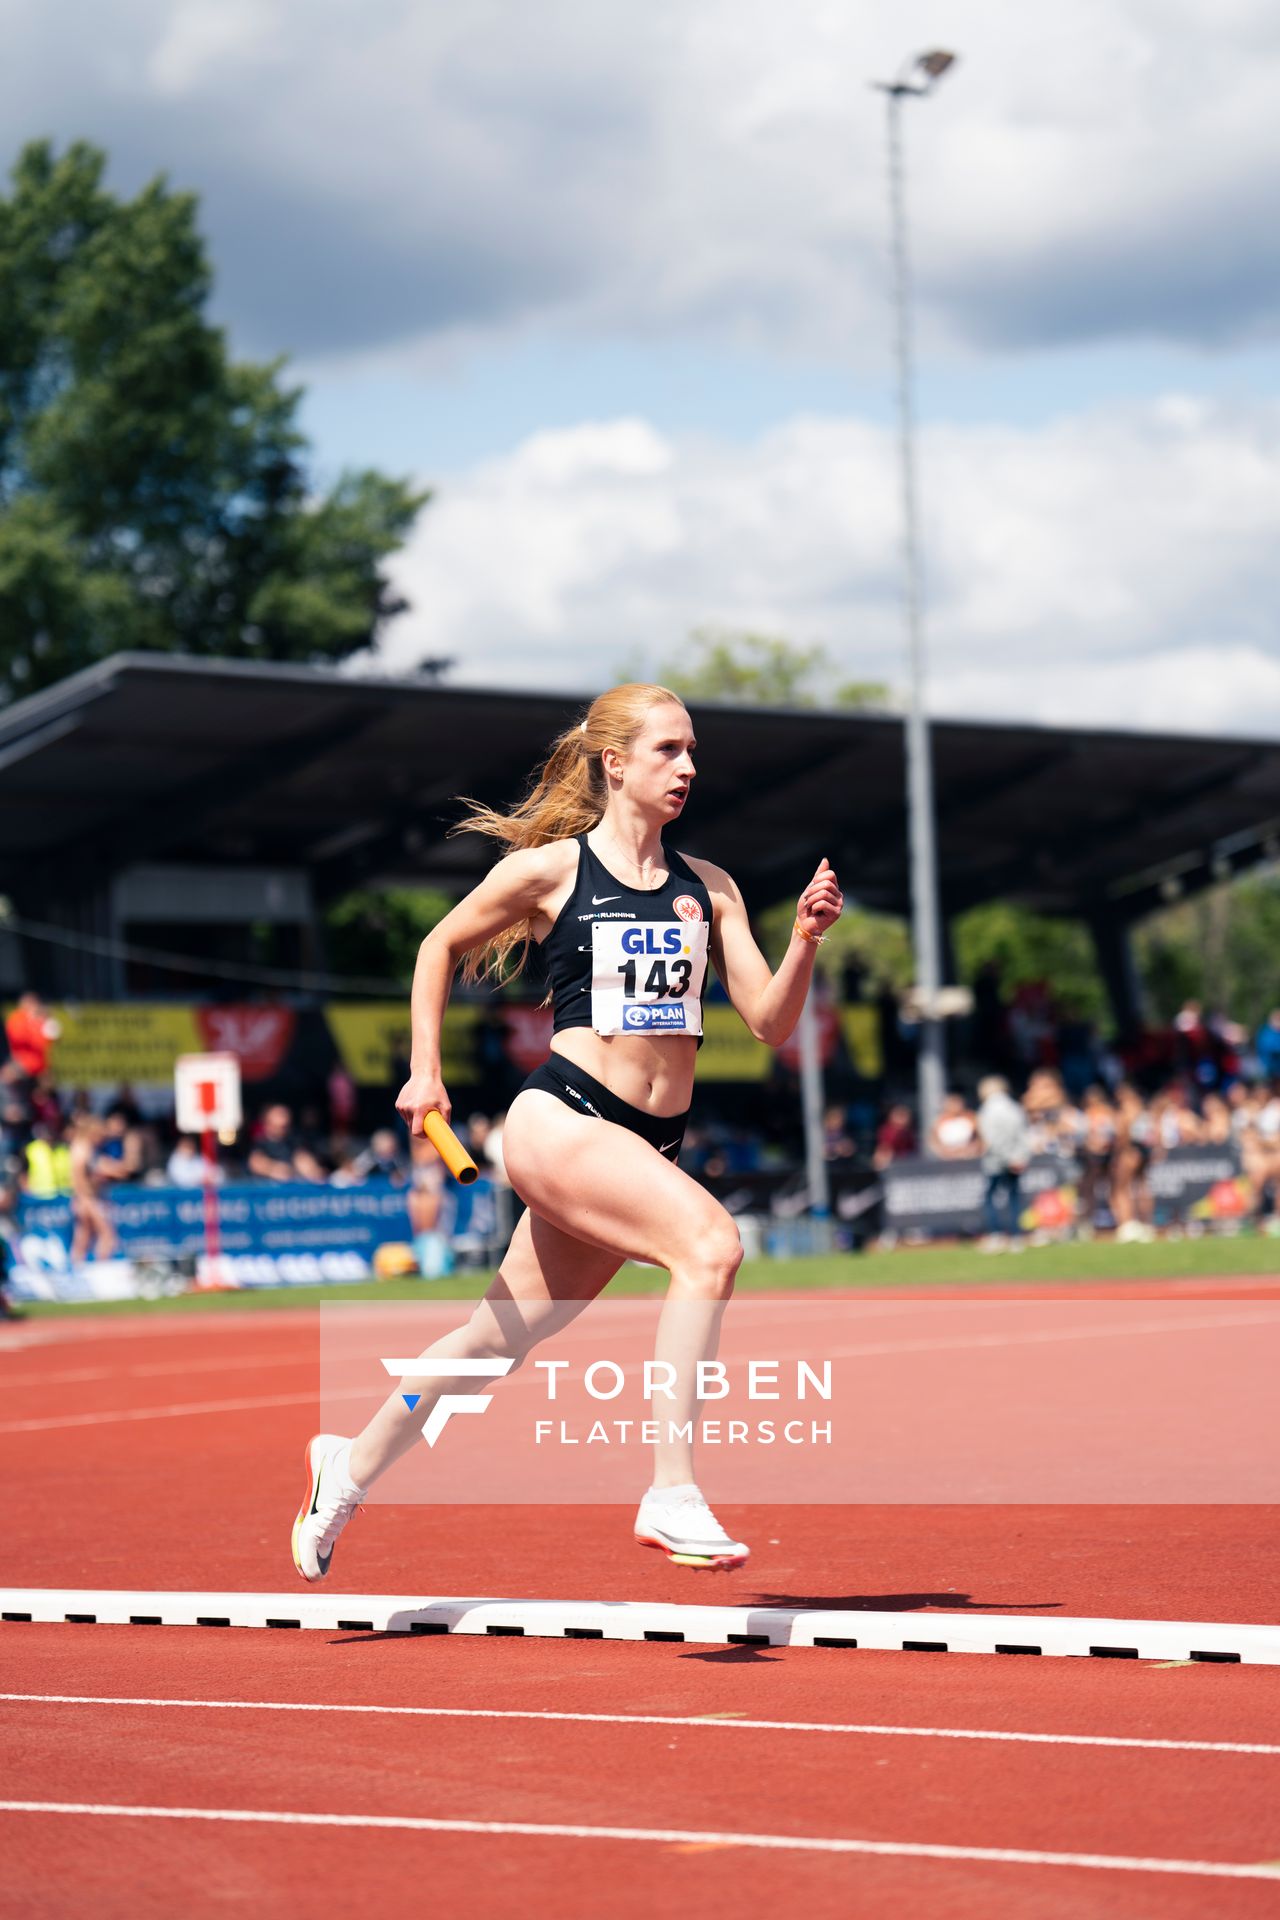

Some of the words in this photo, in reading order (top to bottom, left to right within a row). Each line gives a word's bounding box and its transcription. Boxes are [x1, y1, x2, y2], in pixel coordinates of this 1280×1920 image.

[577, 912, 637, 922] TOP4RUNNING
[617, 959, 693, 999] 143
[651, 1007, 684, 1020] PLAN
